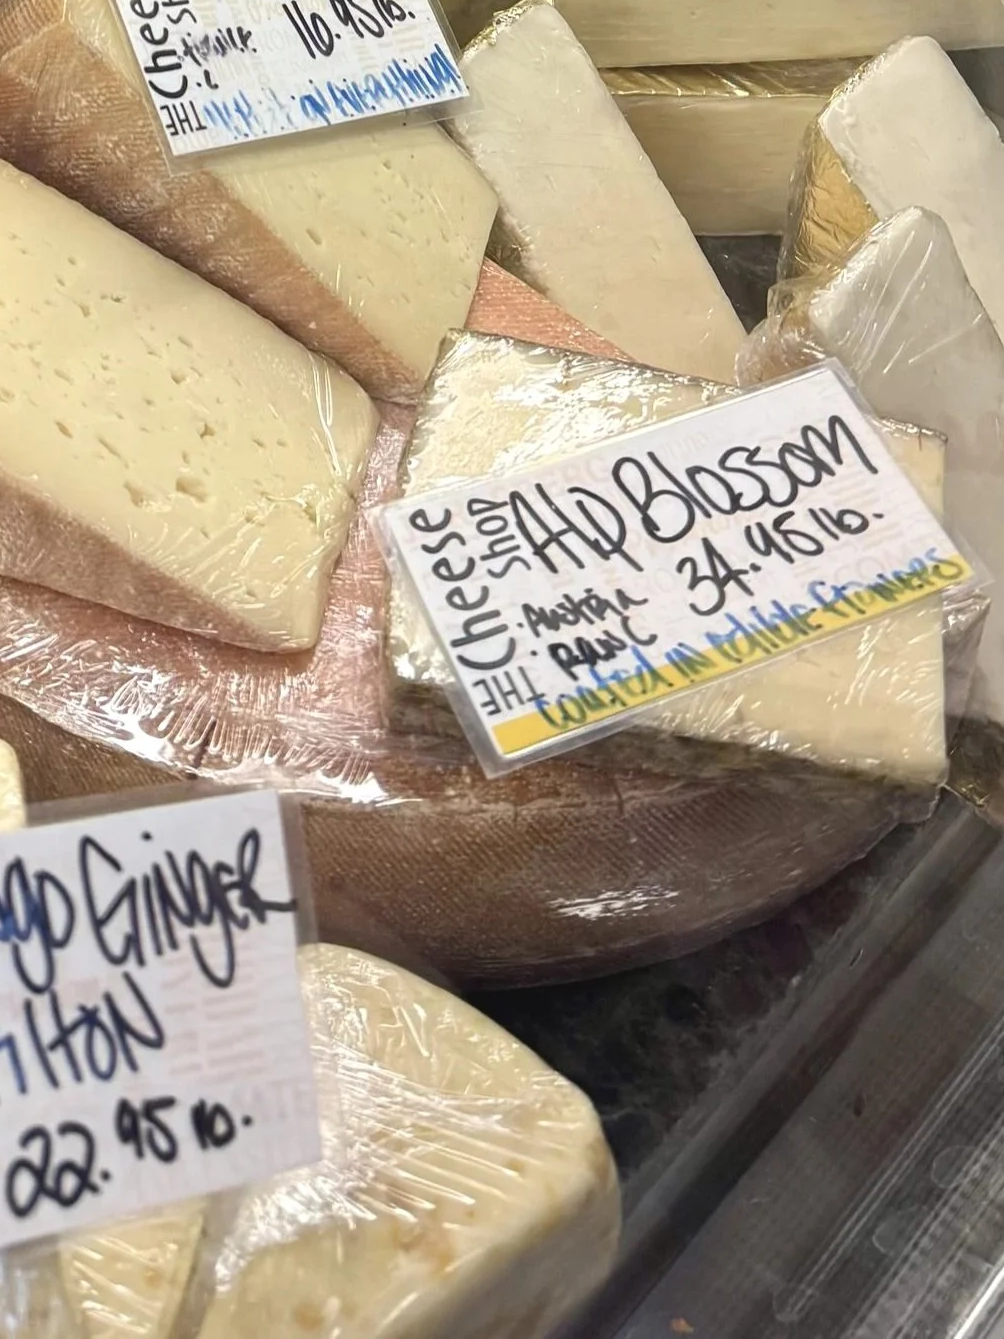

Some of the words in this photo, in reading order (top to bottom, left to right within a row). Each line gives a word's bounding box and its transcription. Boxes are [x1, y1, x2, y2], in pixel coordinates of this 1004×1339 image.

[160, 100, 207, 137] THE
[407, 505, 518, 672] Cheese
[471, 667, 547, 717] THE
[4, 1096, 180, 1218] 22.95
